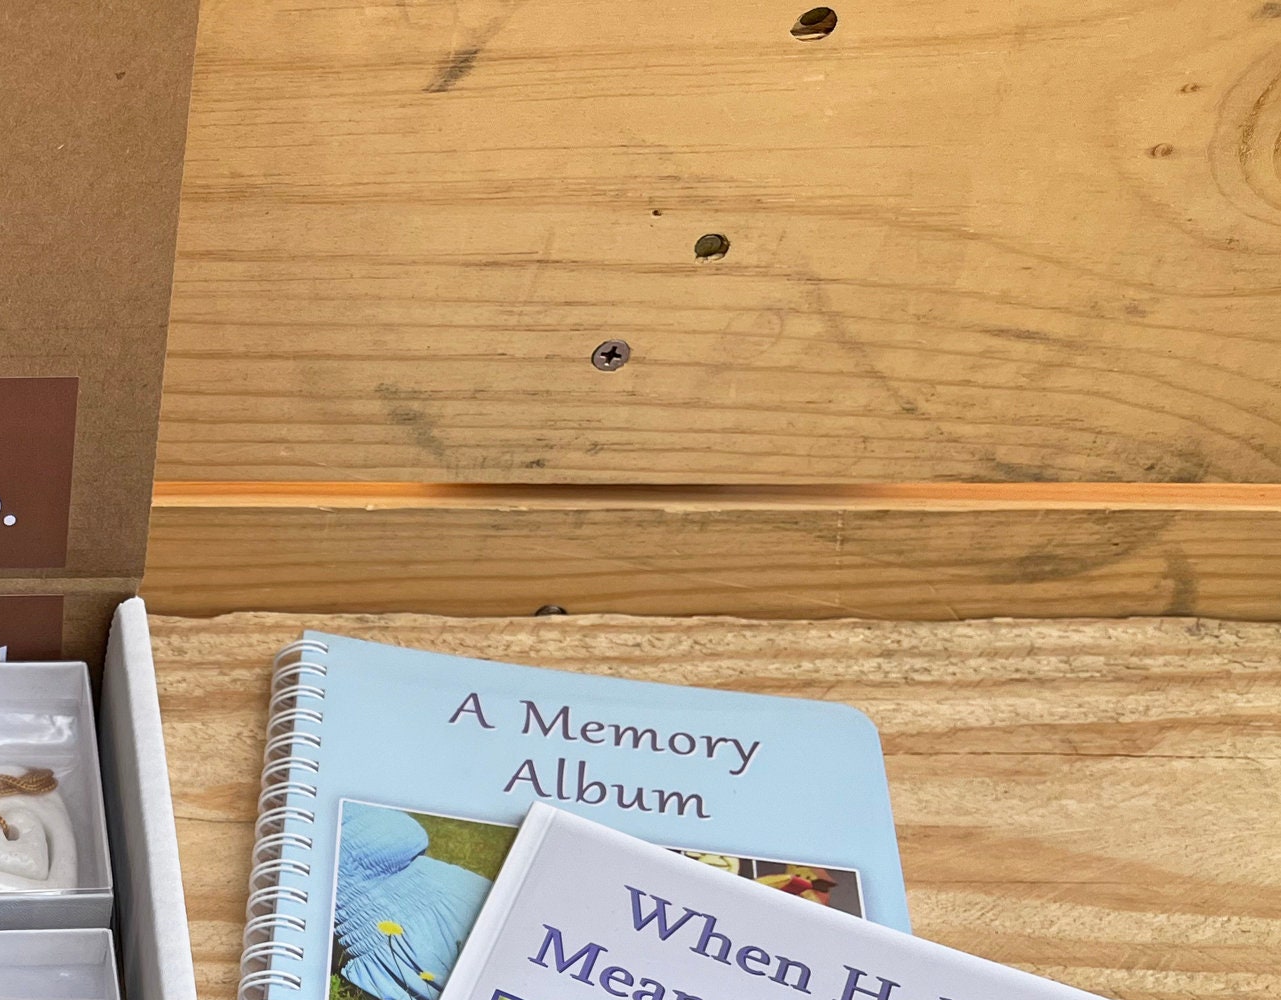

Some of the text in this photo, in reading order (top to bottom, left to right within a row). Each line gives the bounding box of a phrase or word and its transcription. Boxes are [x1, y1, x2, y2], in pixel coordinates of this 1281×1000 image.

[448, 692, 761, 775] A Memory
[503, 759, 712, 821] Album
[623, 885, 812, 996] When
